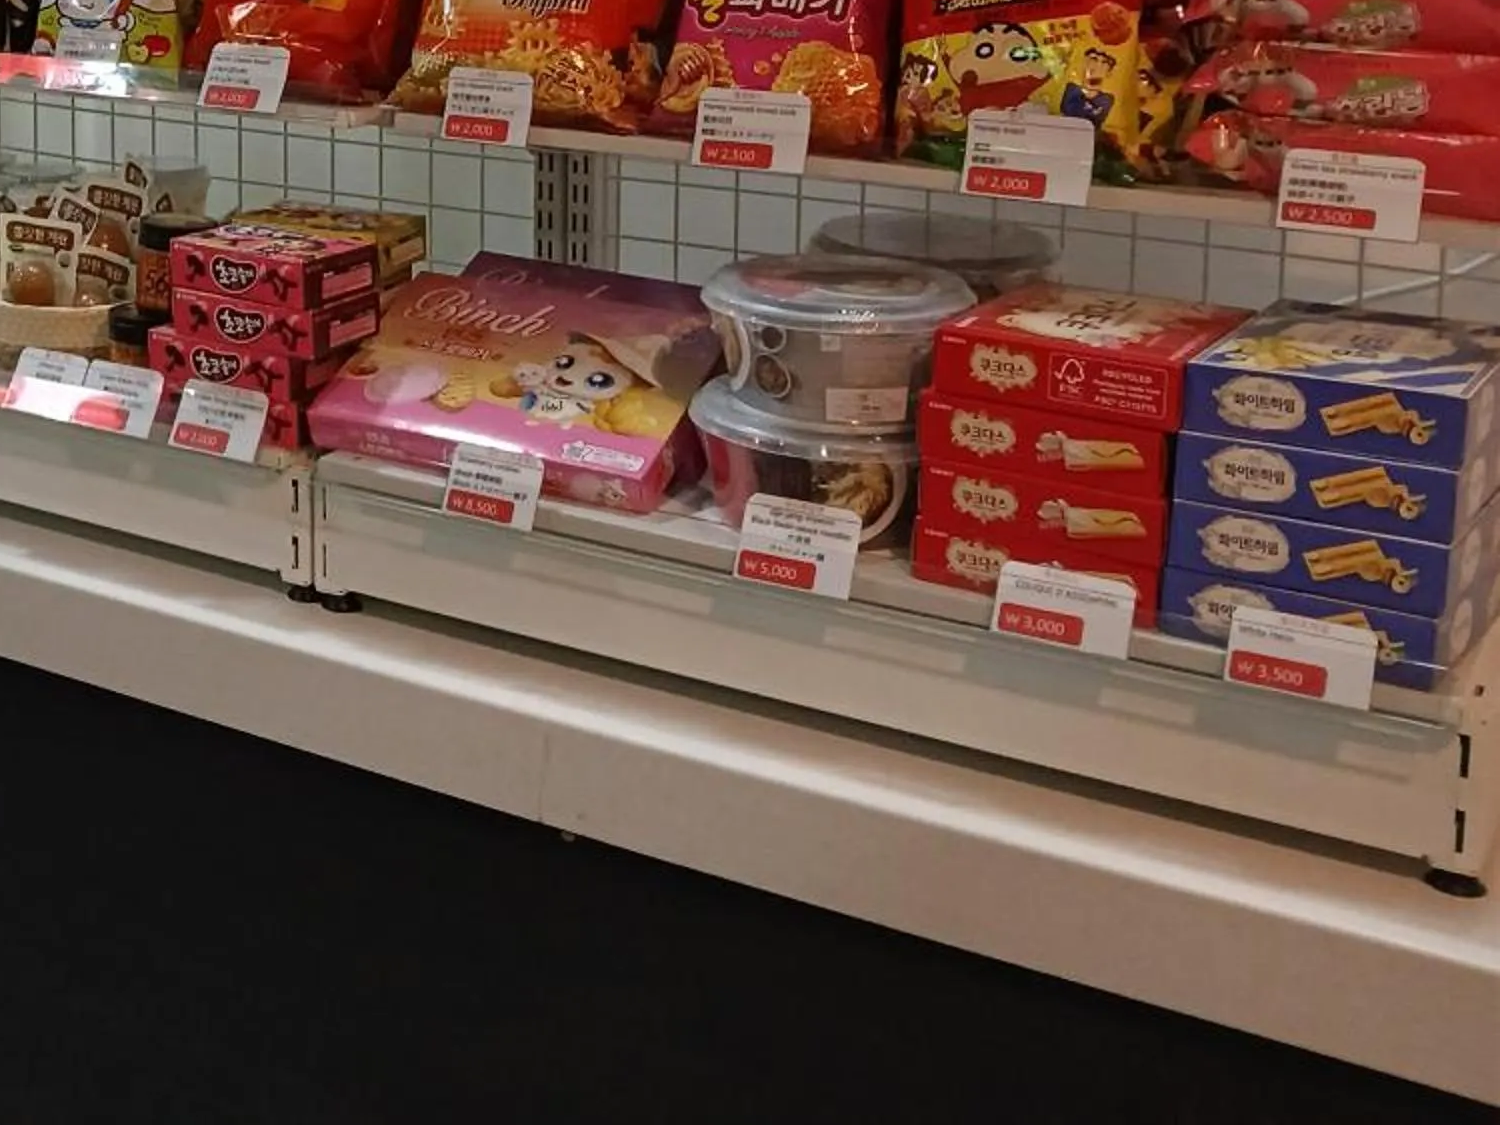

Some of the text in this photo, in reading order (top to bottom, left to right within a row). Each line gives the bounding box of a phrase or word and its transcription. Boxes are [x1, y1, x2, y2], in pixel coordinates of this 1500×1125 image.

[990, 177, 1030, 190] 2,000
[1308, 209, 1353, 225] 2,500
[1233, 391, 1296, 414] 화이트하임
[1224, 462, 1286, 484] 화이트하임
[1218, 533, 1279, 557] 화이트하임
[760, 561, 797, 580] 5,000
[1023, 615, 1066, 636] 3,000
[1257, 663, 1303, 687] 3,500
